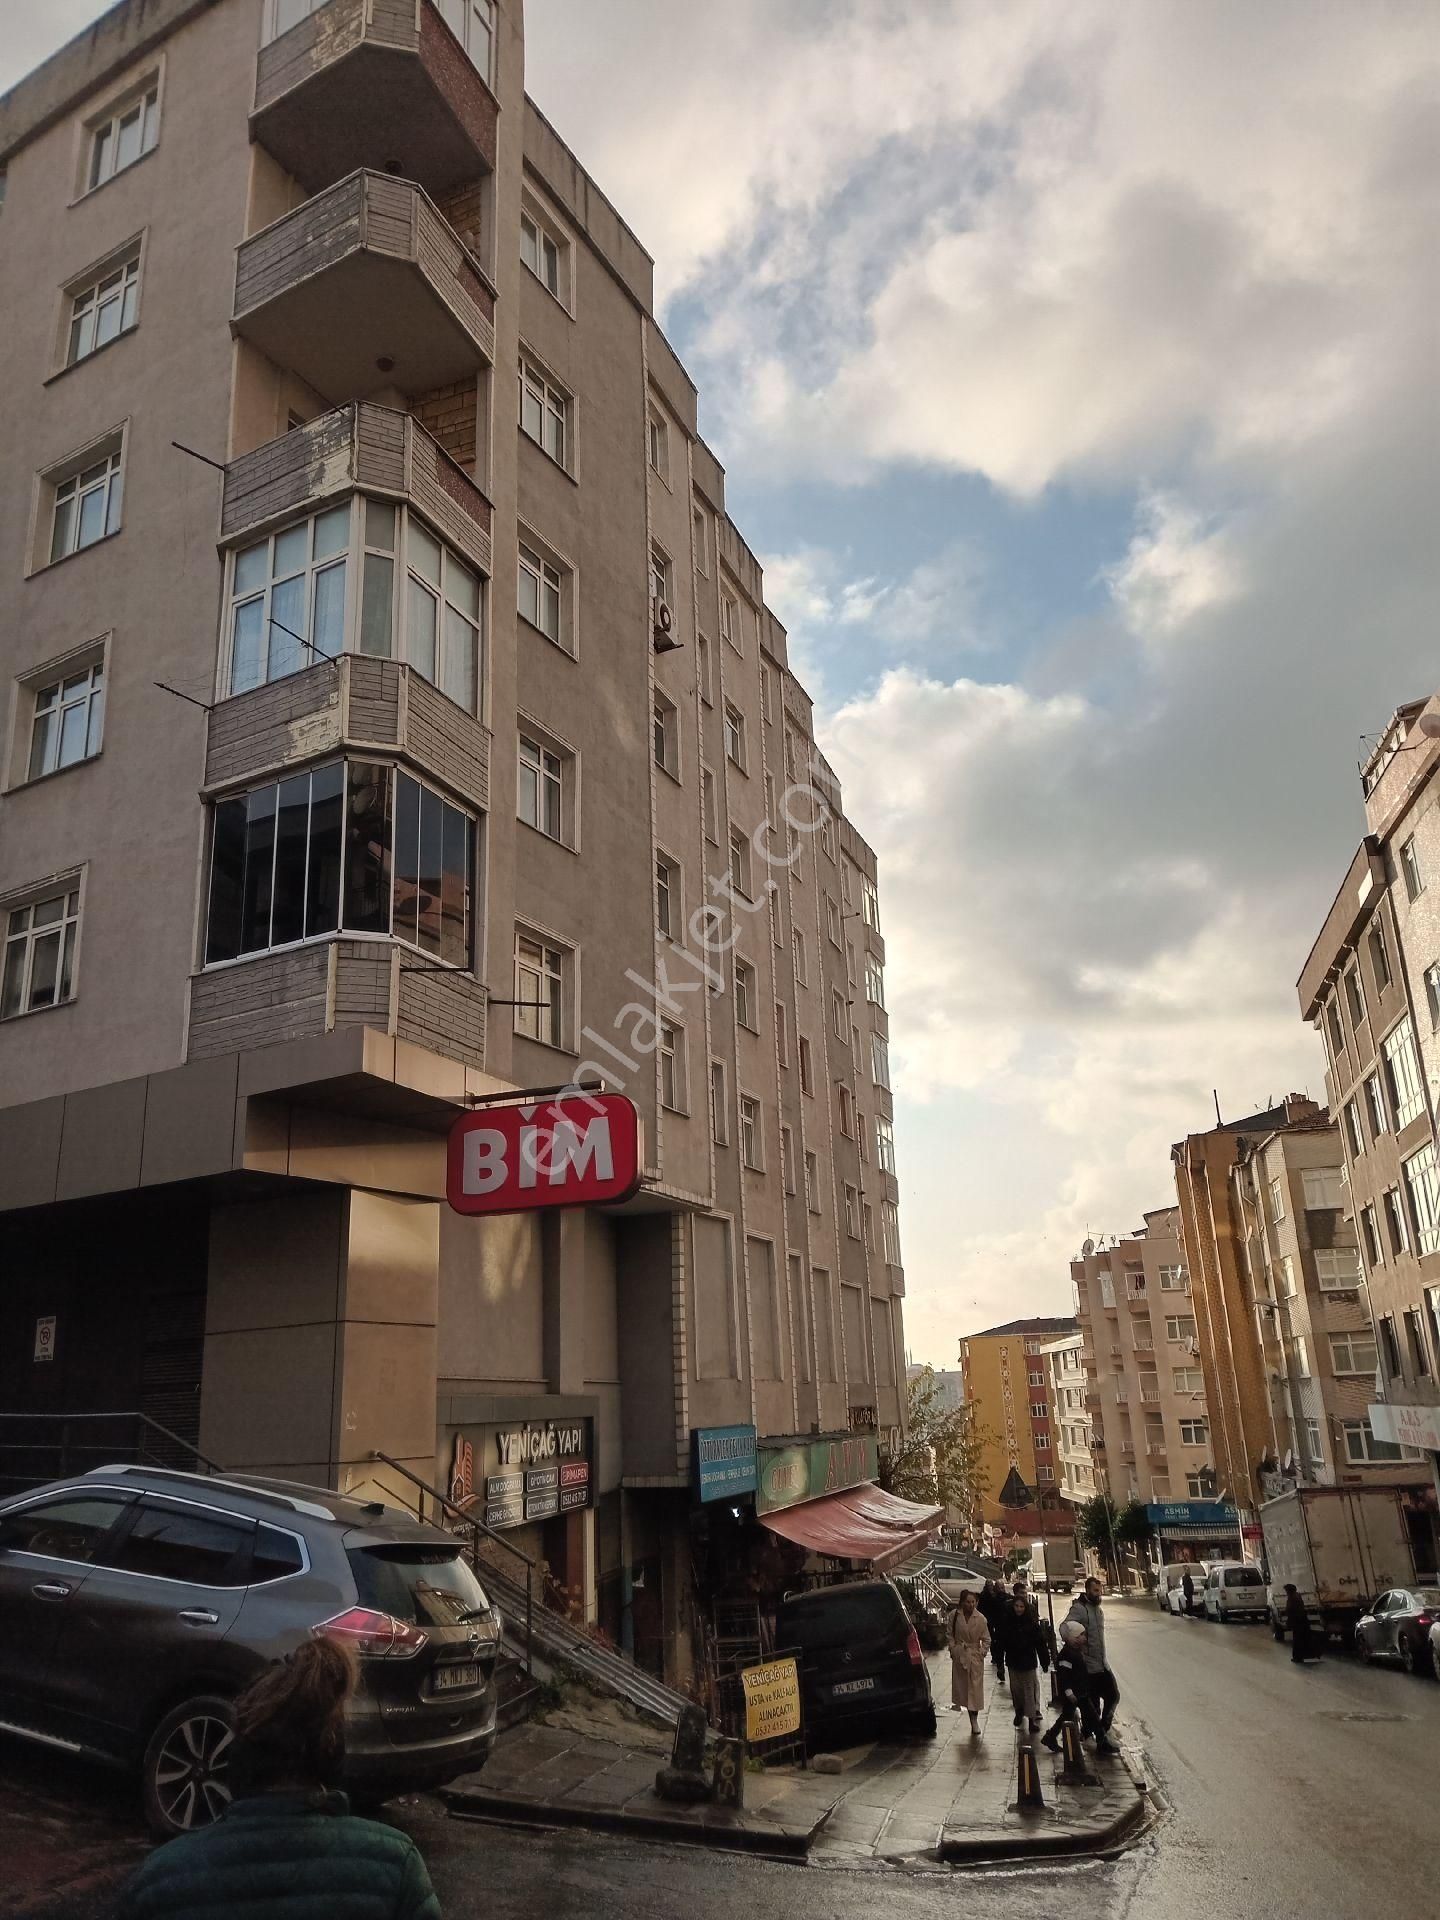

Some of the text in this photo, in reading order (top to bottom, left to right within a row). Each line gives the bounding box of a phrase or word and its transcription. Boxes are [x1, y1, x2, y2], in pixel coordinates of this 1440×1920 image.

[462, 1105, 615, 1196] BİM
[500, 1423, 582, 1464] YENİÇAĞ YAPI
[745, 1664, 795, 1688] YENİÇAĞ YAPI
[749, 1695, 765, 1706] USTA
[765, 1694, 772, 1702] ve
